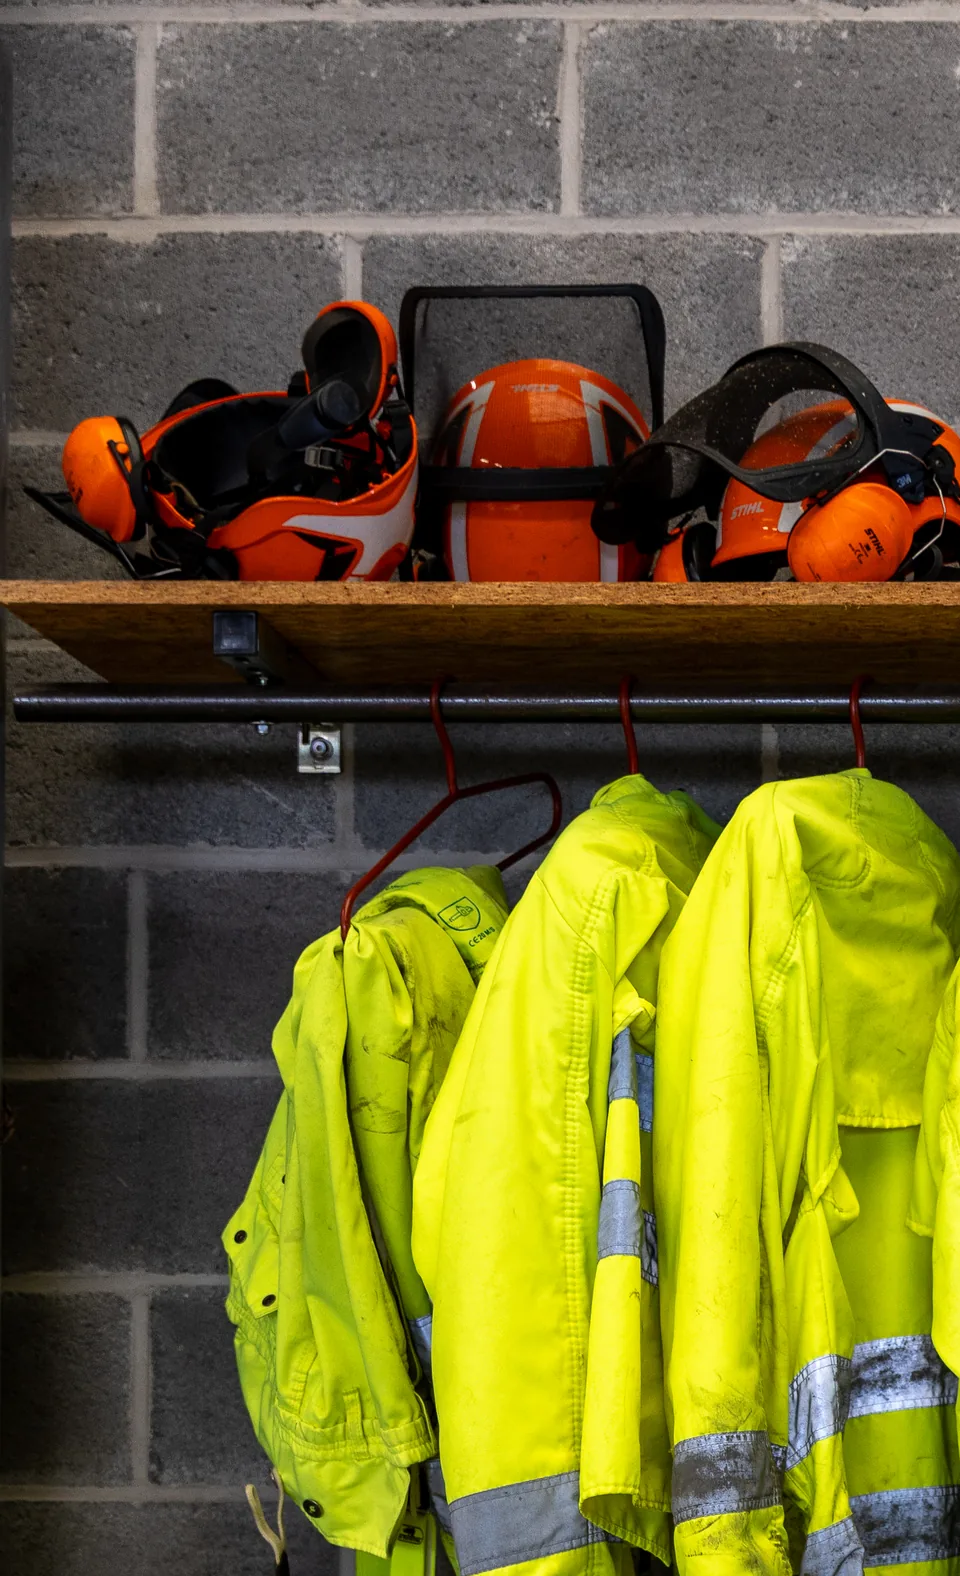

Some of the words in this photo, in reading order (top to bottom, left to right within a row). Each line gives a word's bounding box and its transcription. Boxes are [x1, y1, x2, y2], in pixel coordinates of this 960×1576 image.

[896, 473, 912, 488] 3M
[730, 501, 765, 520] STIHL
[863, 527, 885, 557] STIHL
